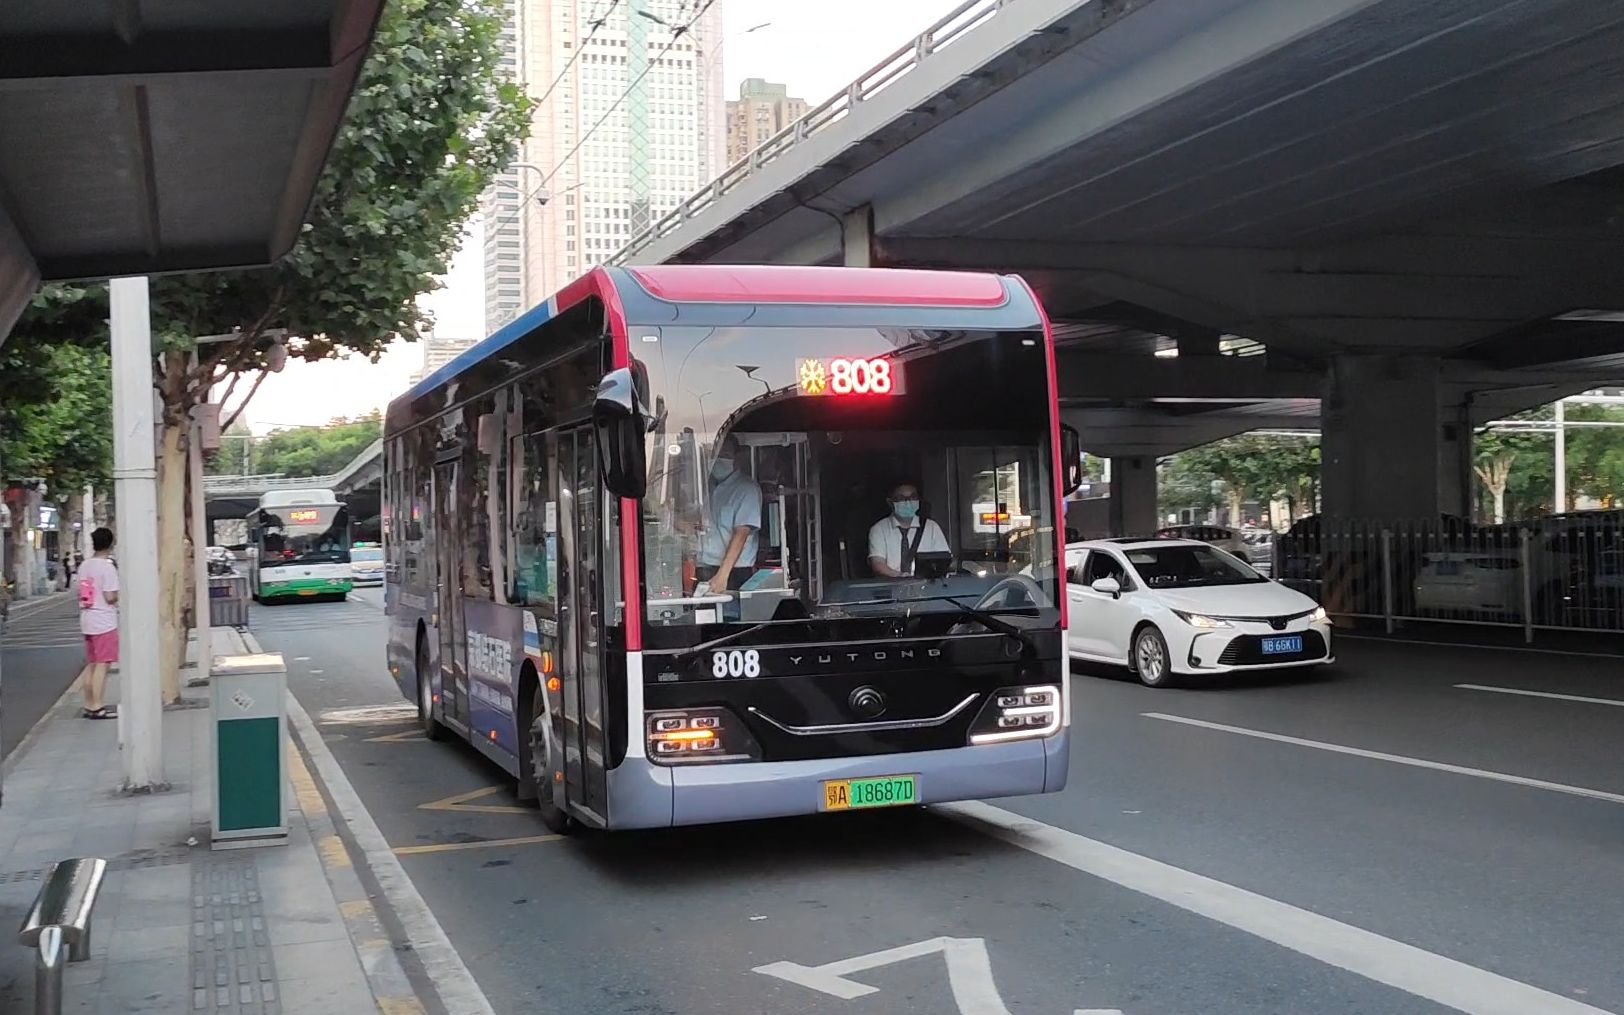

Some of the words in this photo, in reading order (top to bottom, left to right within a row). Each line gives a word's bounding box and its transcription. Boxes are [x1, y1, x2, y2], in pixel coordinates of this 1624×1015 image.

[830, 359, 891, 394] 808
[712, 650, 760, 678] 808
[789, 649, 941, 665] YUTONG
[857, 780, 913, 803] 18687D
